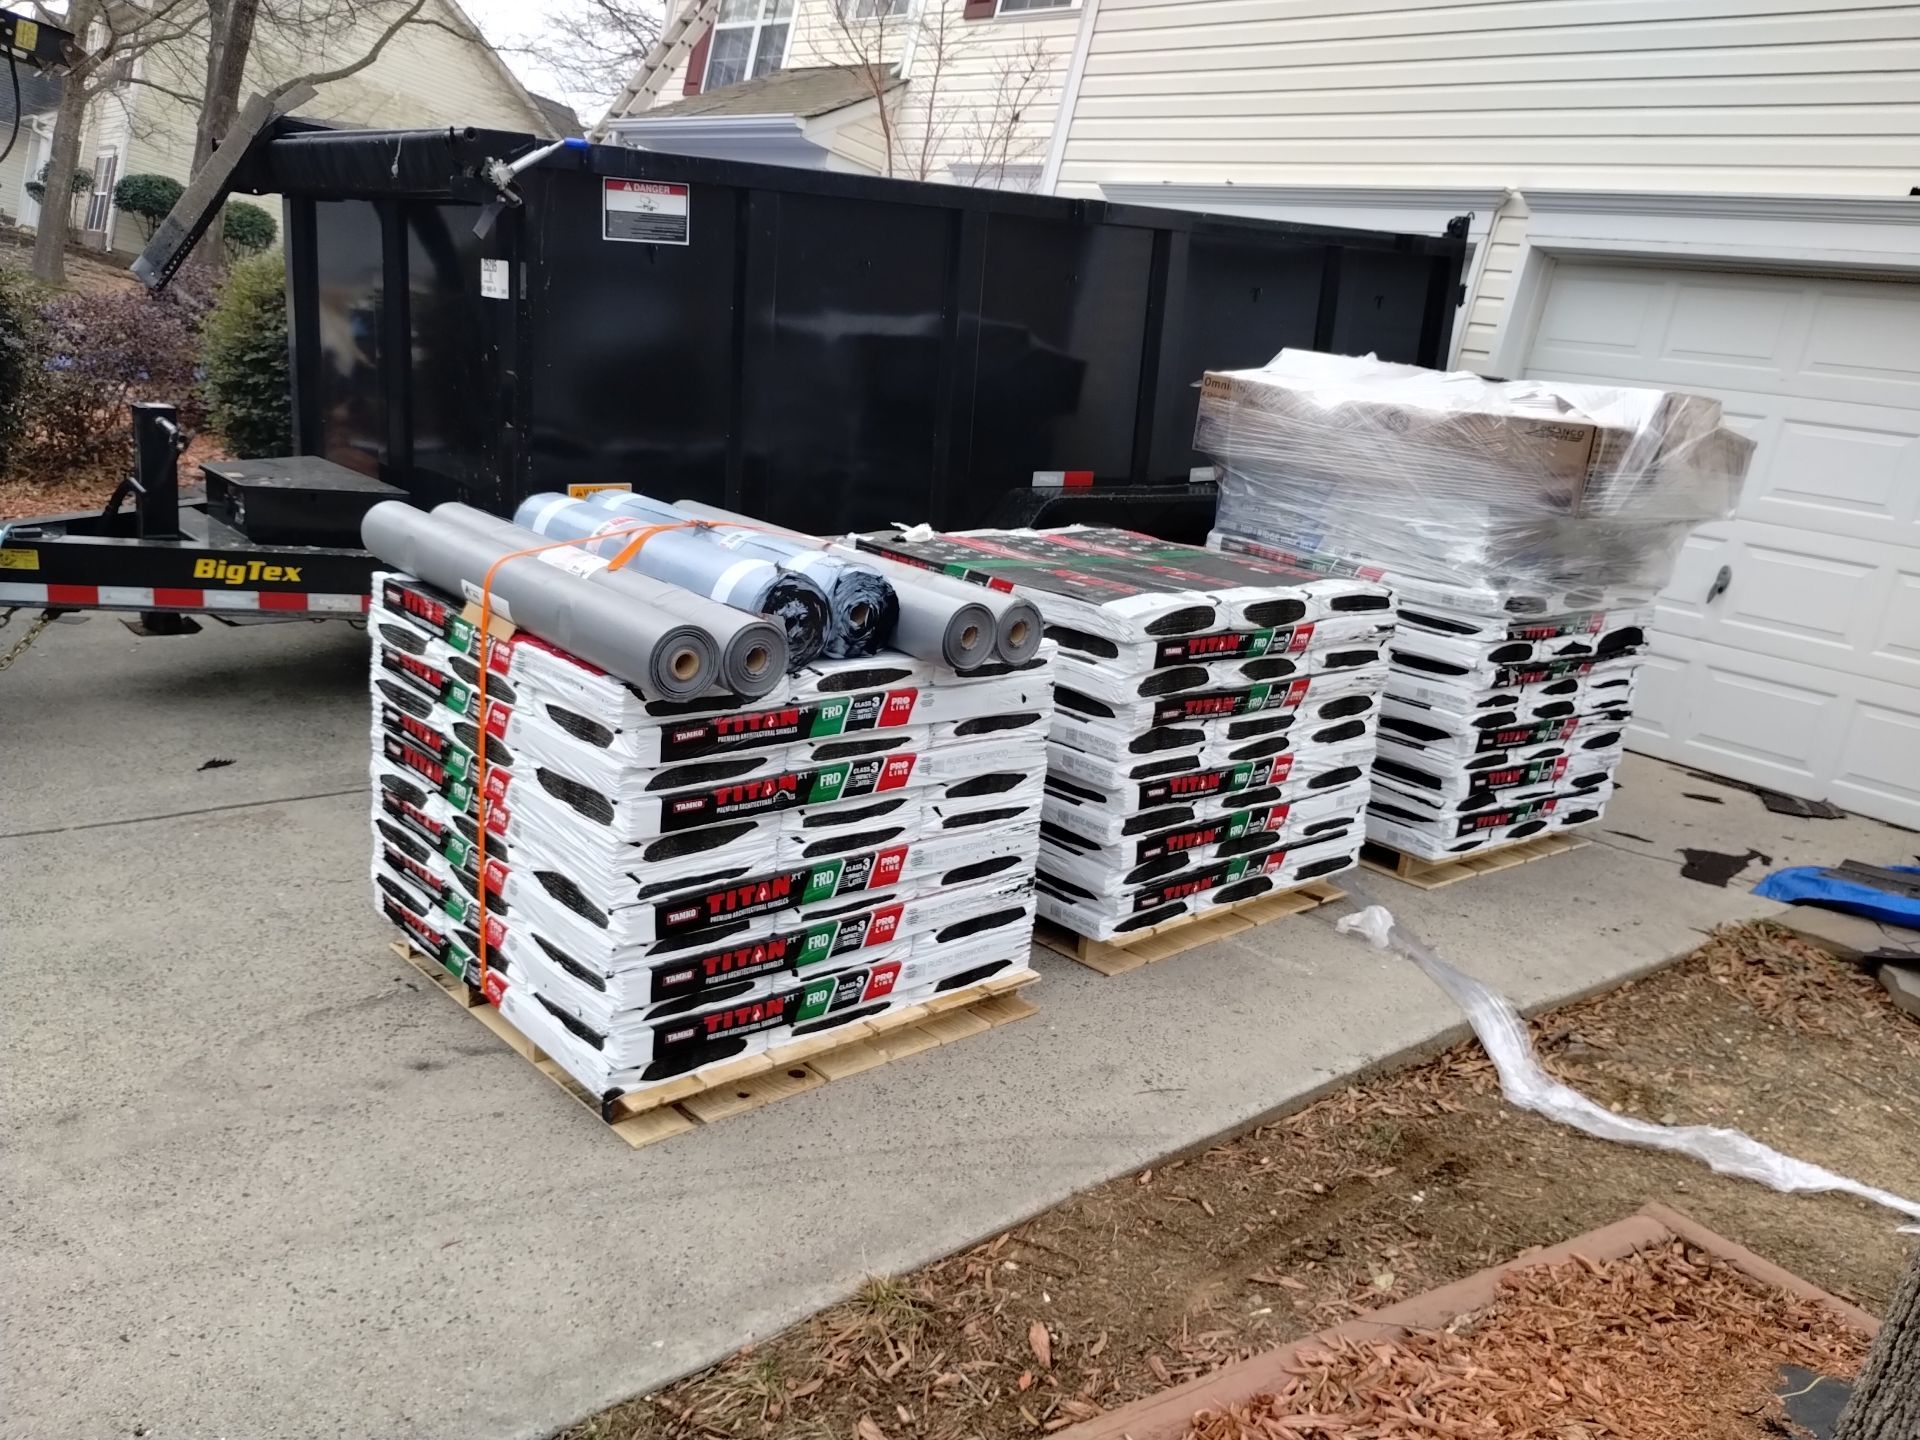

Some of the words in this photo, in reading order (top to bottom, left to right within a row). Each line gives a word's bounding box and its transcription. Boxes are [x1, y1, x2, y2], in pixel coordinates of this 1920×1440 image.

[633, 183, 670, 194] DANGER
[193, 558, 303, 585] BigTex
[1188, 632, 1240, 655] TITAN
[1253, 637, 1267, 649] FRD
[1284, 633, 1291, 642] 3
[854, 700, 872, 708] CLASS
[872, 696, 880, 708] 3
[891, 696, 911, 705] PRO
[1279, 690, 1286, 700] 3
[822, 704, 843, 719] FRD
[890, 704, 910, 712] LINE
[1184, 696, 1235, 715] TITAN
[715, 706, 799, 734] TITAN
[676, 729, 704, 741] TAMKO
[717, 734, 740, 743] PREMIUM
[740, 729, 776, 740] ARCHITECTURAL
[775, 726, 798, 736] SHINGLES
[853, 766, 871, 775] CLASS
[870, 761, 879, 773] 3
[889, 761, 909, 770] PRO
[1264, 765, 1271, 775] 3
[820, 772, 842, 787] FRD
[888, 769, 908, 777] LINE
[1234, 772, 1248, 784] FRD
[712, 773, 797, 805] TITAN
[1169, 772, 1220, 793] TITAN
[675, 800, 703, 812] TAMKO
[716, 804, 739, 814] PREMIUM
[738, 798, 773, 810] ARCHITECTURAL
[1259, 816, 1266, 827] 3
[1229, 824, 1243, 838] FRD
[1166, 829, 1216, 851] TITAN
[845, 863, 863, 873] CLASS
[862, 857, 871, 871] 3
[880, 855, 900, 866] PRO
[880, 863, 900, 873] LINE
[813, 870, 835, 889] FRD
[706, 874, 791, 914] TITAN
[1163, 877, 1213, 900] TITAN
[669, 908, 696, 923] TAMKO
[710, 913, 733, 923] PREMIUM
[732, 904, 768, 919] ARCHITECTURAL
[840, 924, 858, 934] CLASS
[857, 920, 866, 932] 3
[875, 915, 896, 927] PRO
[875, 924, 895, 934] LINE
[807, 933, 830, 950] FRD
[702, 937, 787, 976] TITAN
[665, 970, 693, 984] TAMKO
[705, 974, 728, 985] PREMIUM
[727, 964, 763, 980] ARCHITECTURAL
[874, 971, 894, 984] PRO
[839, 981, 856, 991] CLASS
[856, 975, 865, 988] 3
[806, 990, 828, 1007] FRD
[704, 997, 785, 1033] TITAN
[667, 1028, 694, 1042] TAMKO
